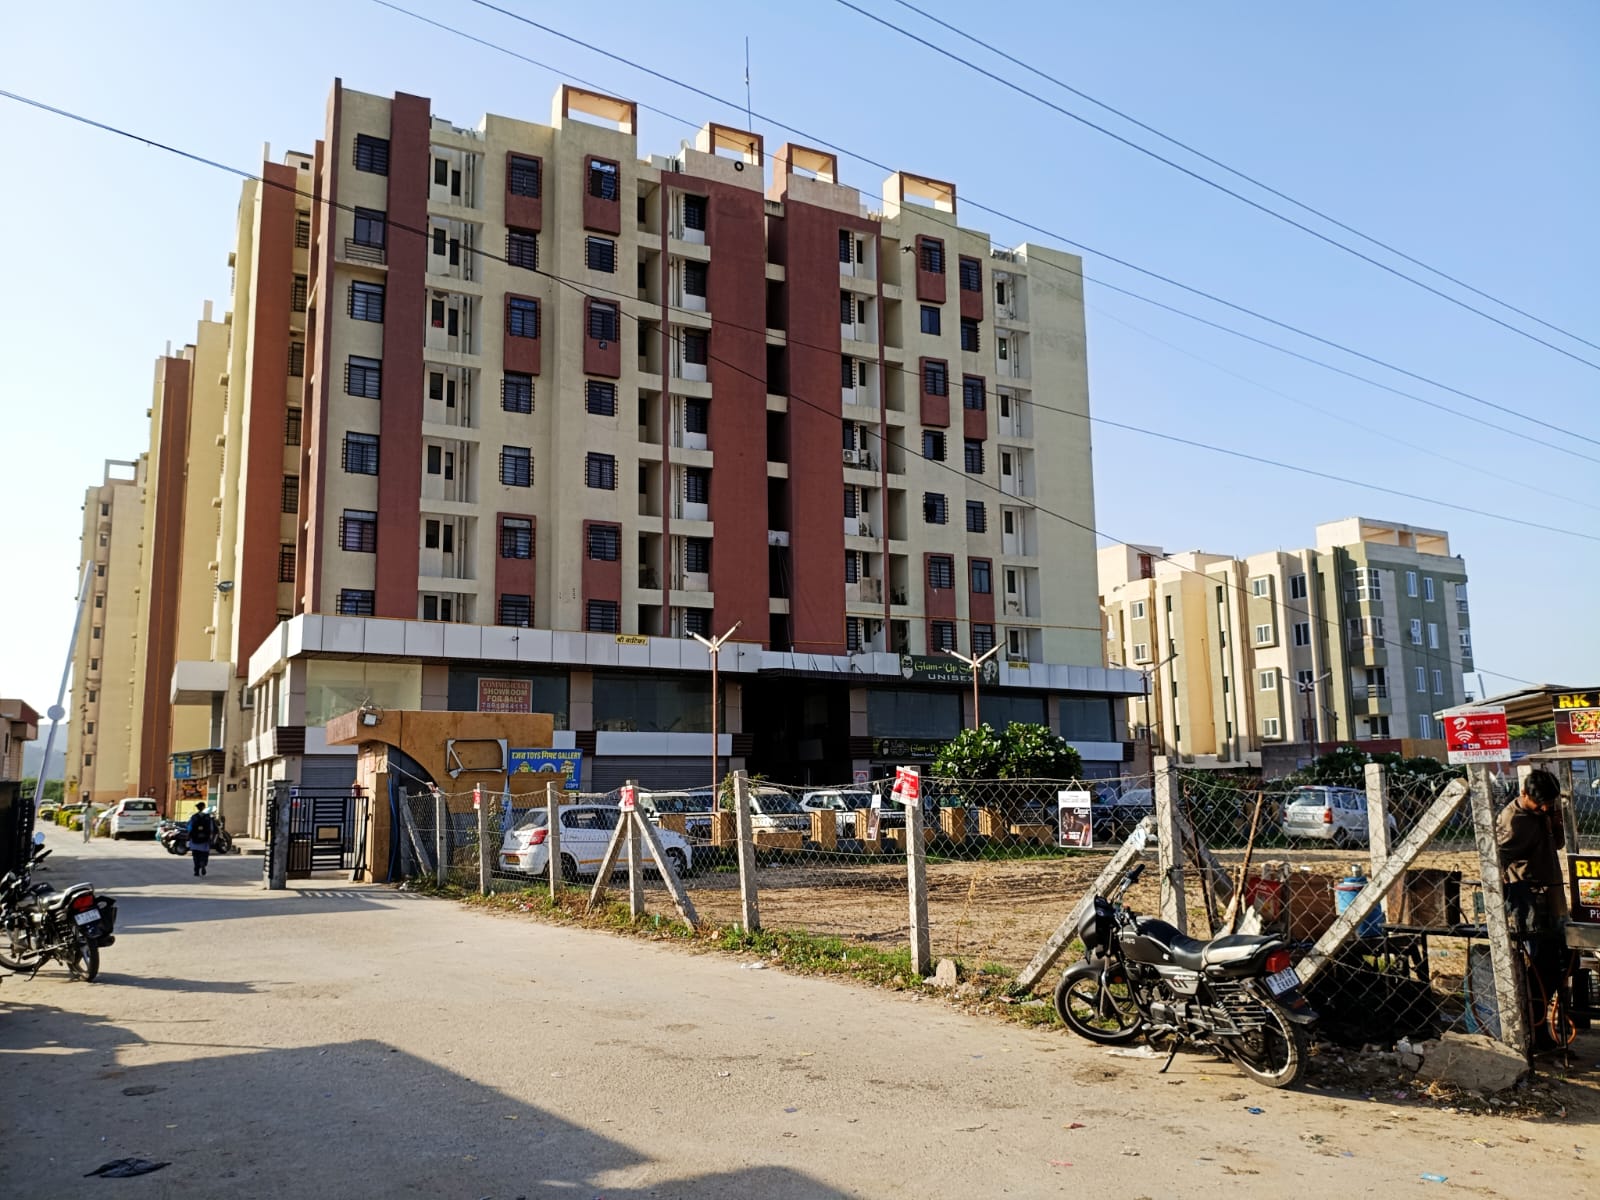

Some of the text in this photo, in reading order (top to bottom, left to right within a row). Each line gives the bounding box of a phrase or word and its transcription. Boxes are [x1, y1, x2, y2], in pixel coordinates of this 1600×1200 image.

[928, 673, 974, 681] UNISEX
[481, 680, 529, 689] COMMERCIAL
[483, 688, 528, 696] SHOWROOM
[1558, 693, 1590, 708] RK
[557, 752, 581, 760] GALLERY
